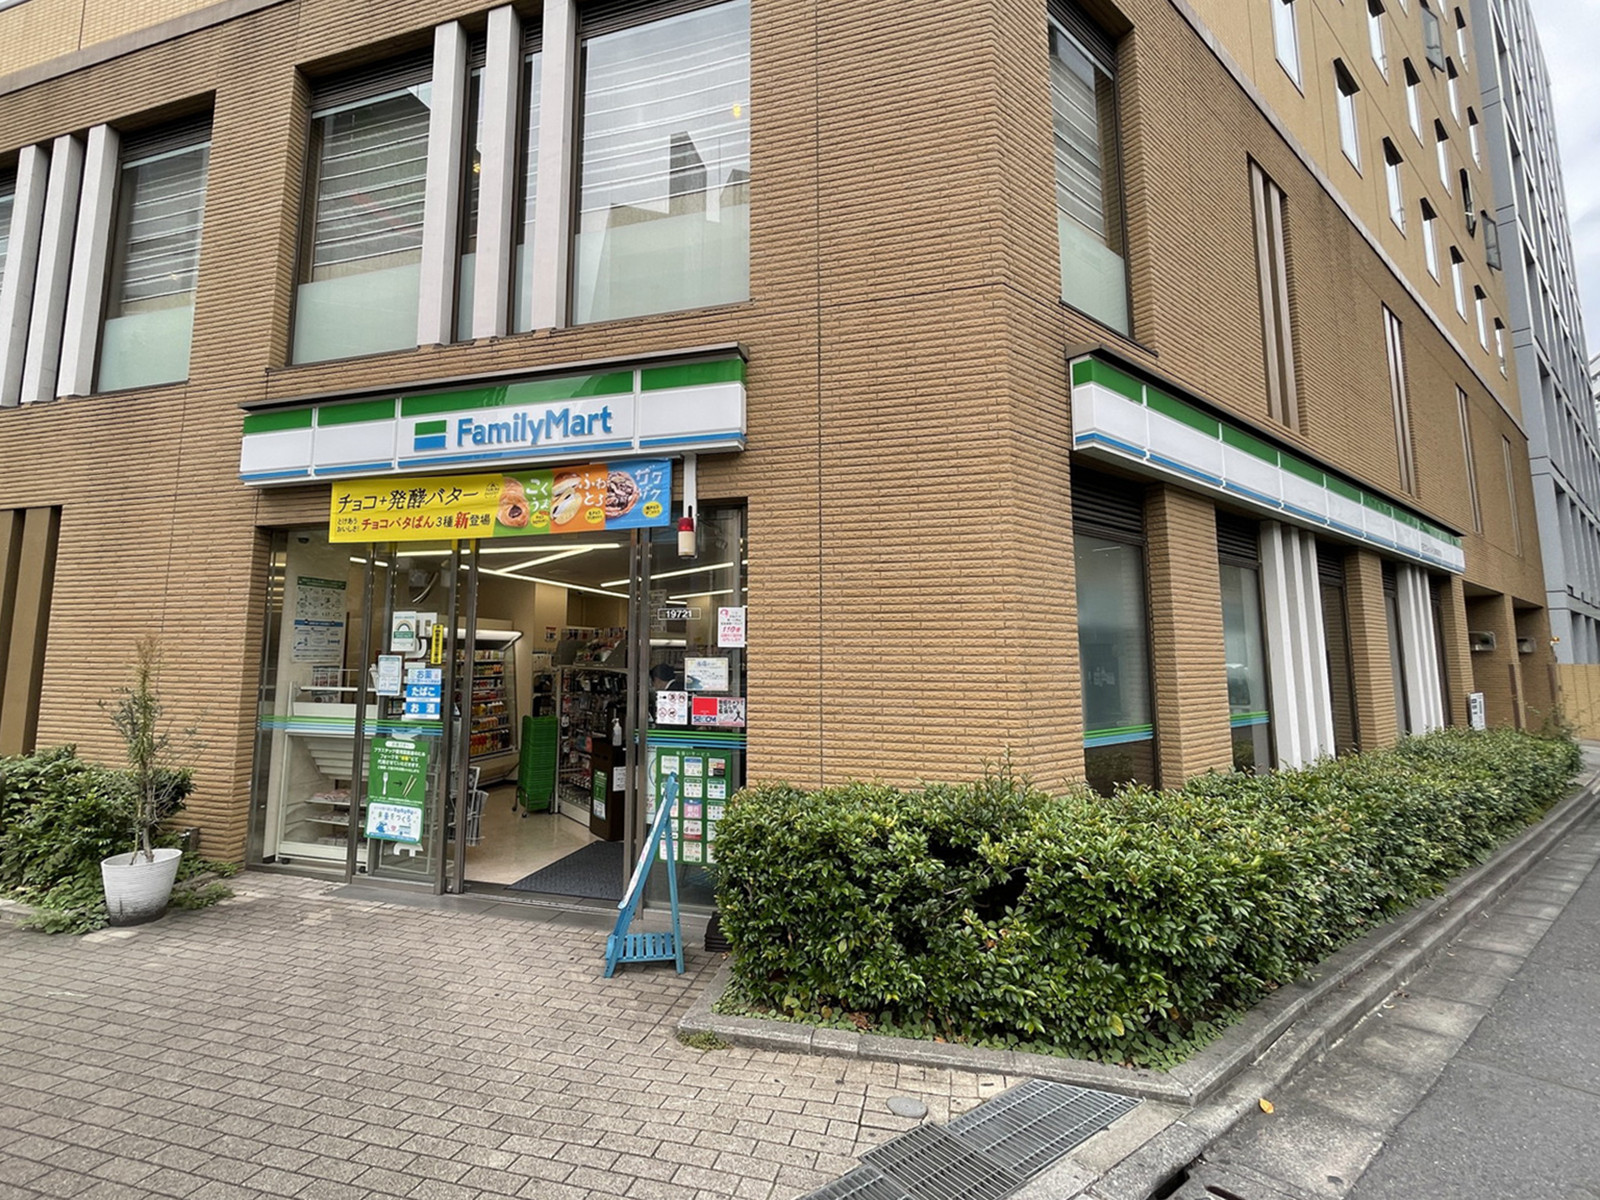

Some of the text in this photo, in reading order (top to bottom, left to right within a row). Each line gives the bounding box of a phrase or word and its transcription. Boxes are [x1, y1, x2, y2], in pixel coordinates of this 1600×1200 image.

[457, 405, 612, 447] FamilyMart
[338, 487, 478, 514] チョコ+発酵バター
[666, 610, 692, 619] 19721
[411, 686, 435, 697] たばこ
